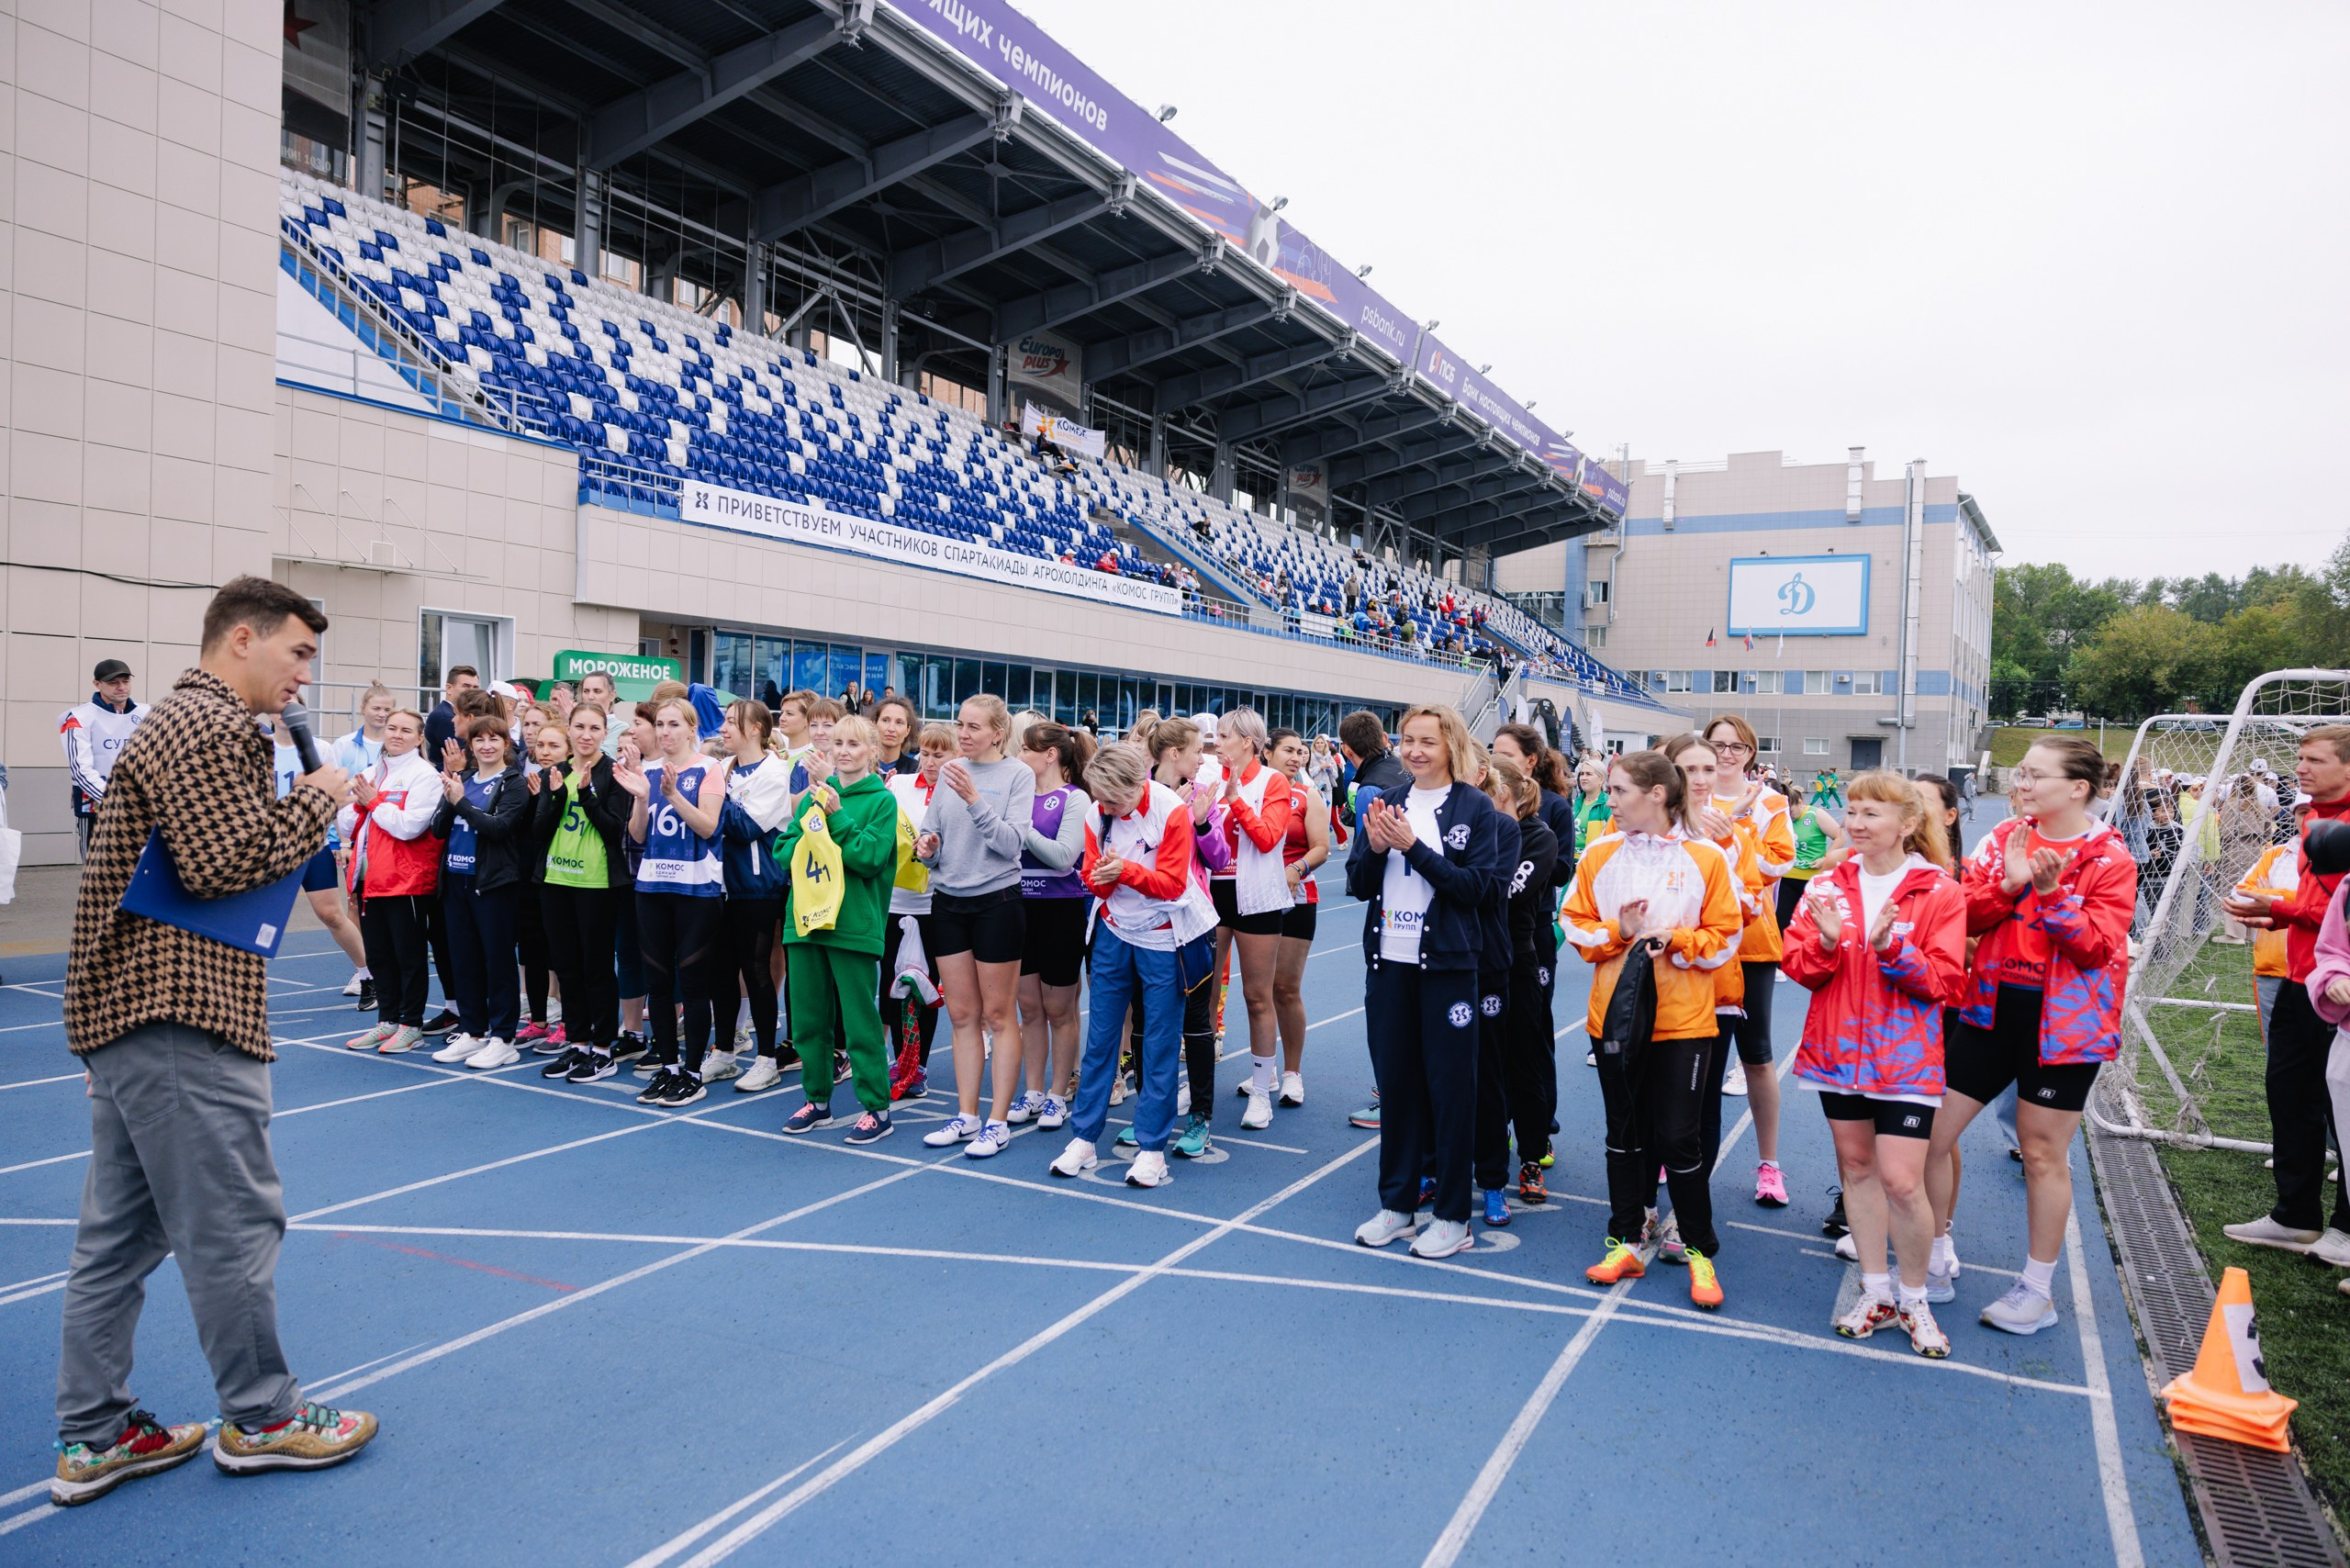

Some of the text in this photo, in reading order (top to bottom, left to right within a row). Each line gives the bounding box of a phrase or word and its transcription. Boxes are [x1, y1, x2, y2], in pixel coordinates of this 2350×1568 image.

[928, 0, 1108, 131] ящих чемпионов
[1361, 305, 1405, 347] psbank.ru
[1438, 358, 1541, 446] ПСБ Банк настоящих чемпионов
[718, 495, 1179, 606] ПРИВЕТСТВУЕМ УЧАСТНИКОВ СПАРТАКИАДЫ АГРОХОЛДИНГА «КОМОС ГРУПП»
[569, 658, 670, 680] МОРОЖЕНОЕ
[453, 854, 476, 863] КОМО
[551, 856, 585, 868] КОМОС
[655, 863, 685, 871] КОМОС
[1394, 910, 1426, 923] КОМ
[1393, 923, 1416, 931] ГРУПП
[2000, 956, 2045, 974] ОМО
